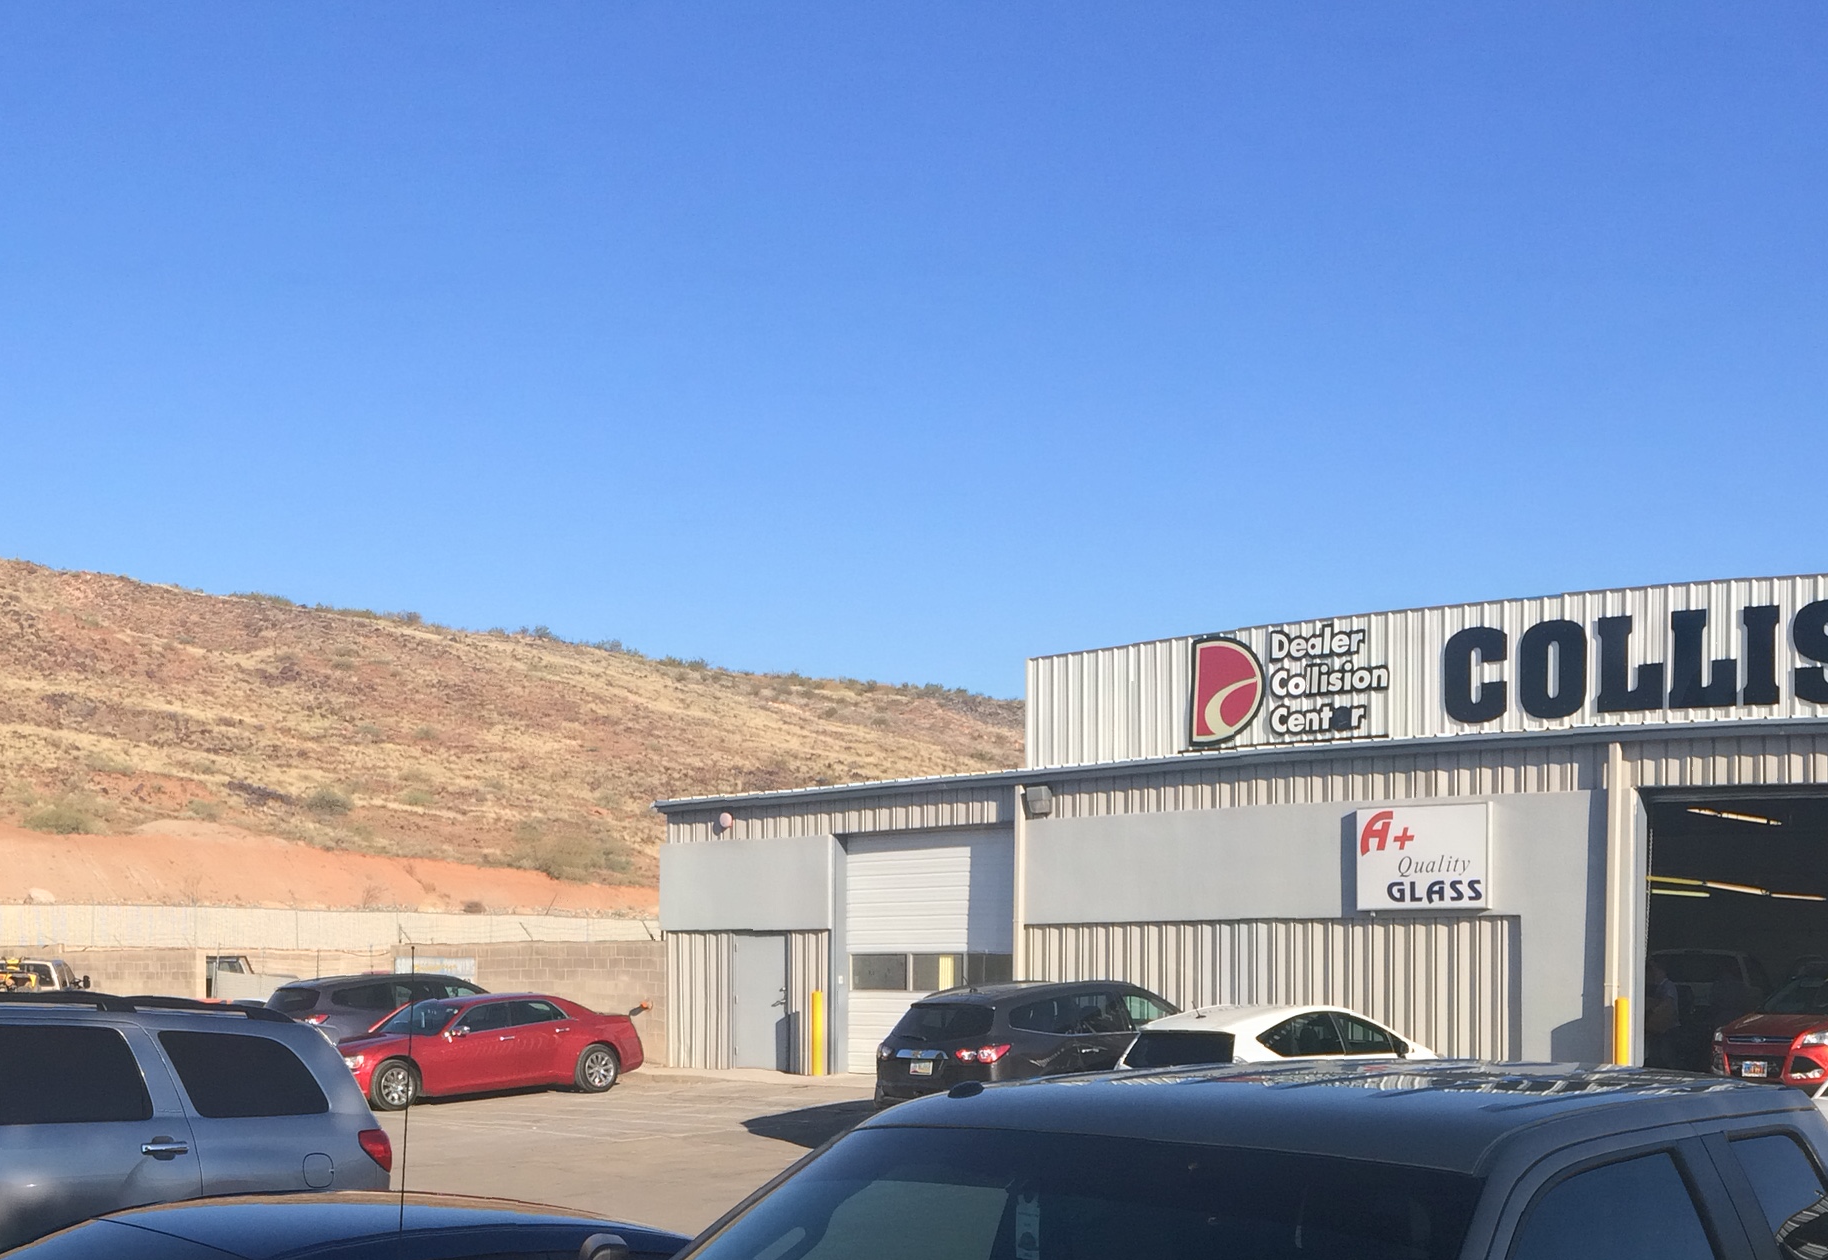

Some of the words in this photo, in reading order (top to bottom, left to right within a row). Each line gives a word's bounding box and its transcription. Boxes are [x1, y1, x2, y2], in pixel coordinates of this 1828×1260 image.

[1271, 625, 1365, 661] Dealer
[1271, 661, 1389, 698] Collision
[1271, 704, 1365, 735] Centr
[1360, 810, 1415, 856] A+
[1397, 855, 1471, 877] Quality
[1386, 880, 1483, 904] GLASS
